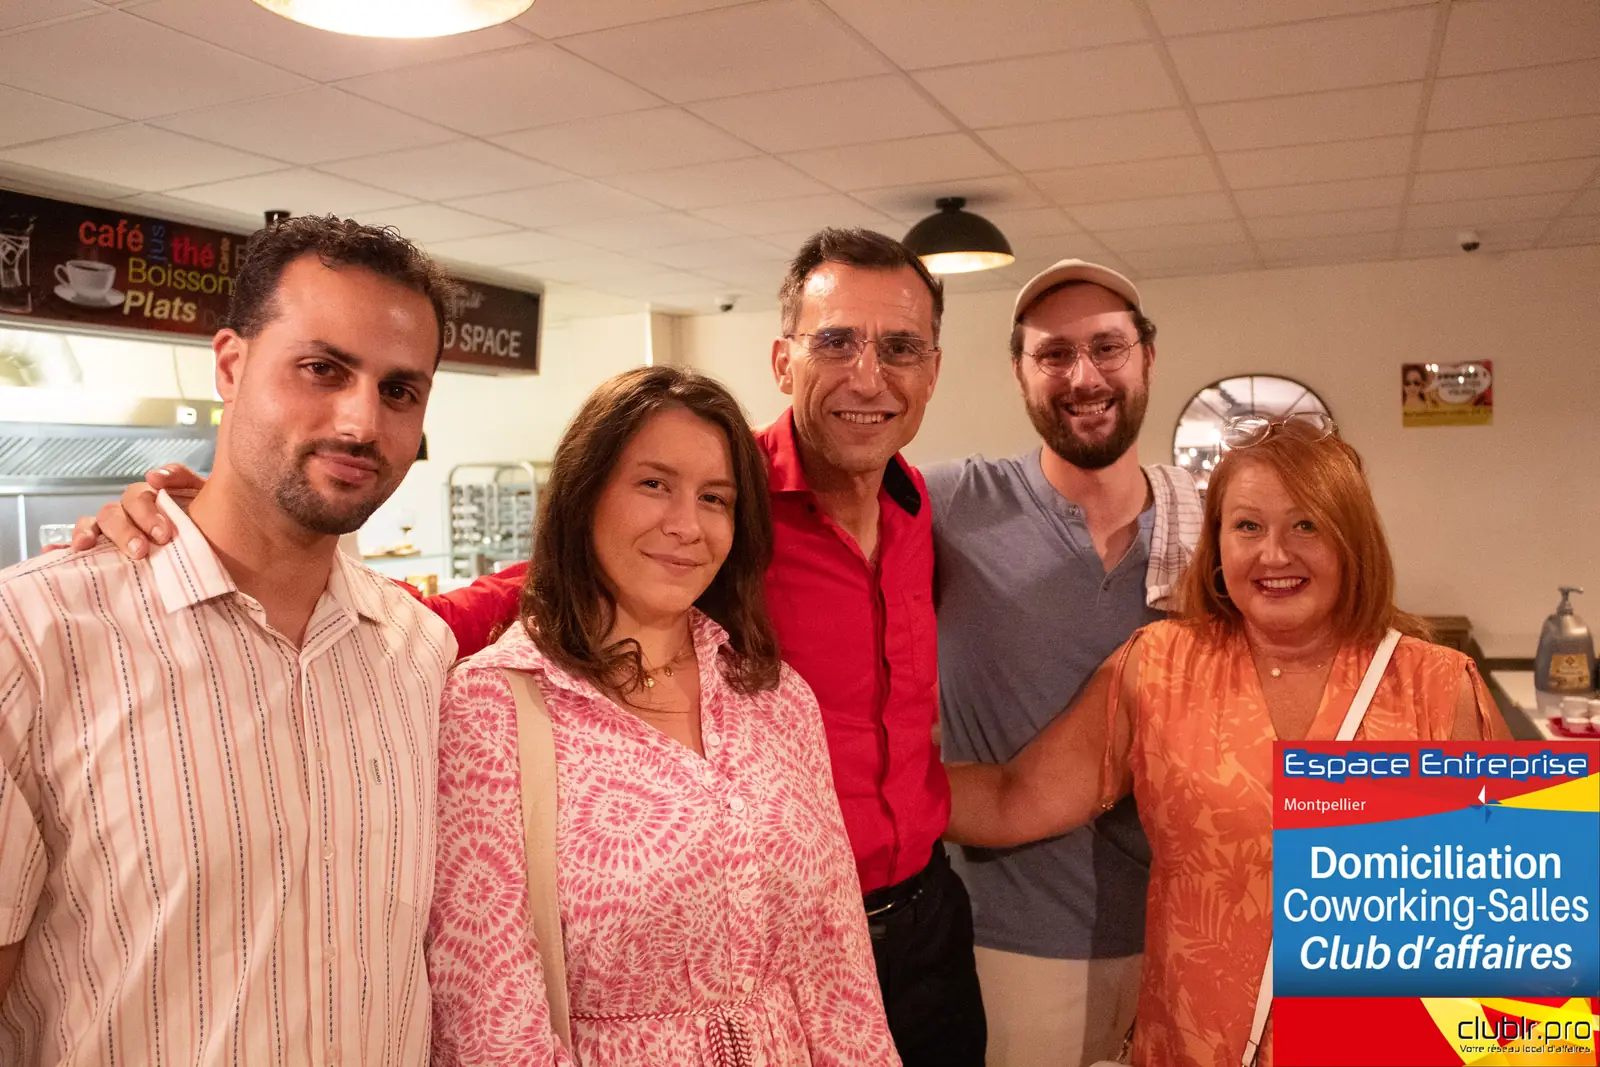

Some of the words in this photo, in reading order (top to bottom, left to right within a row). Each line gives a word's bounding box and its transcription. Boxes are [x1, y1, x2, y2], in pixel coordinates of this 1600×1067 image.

[78, 219, 144, 252] café
[149, 224, 168, 261] jus
[171, 234, 215, 268] thé
[122, 289, 198, 323] Plats
[459, 322, 521, 358] SPACE
